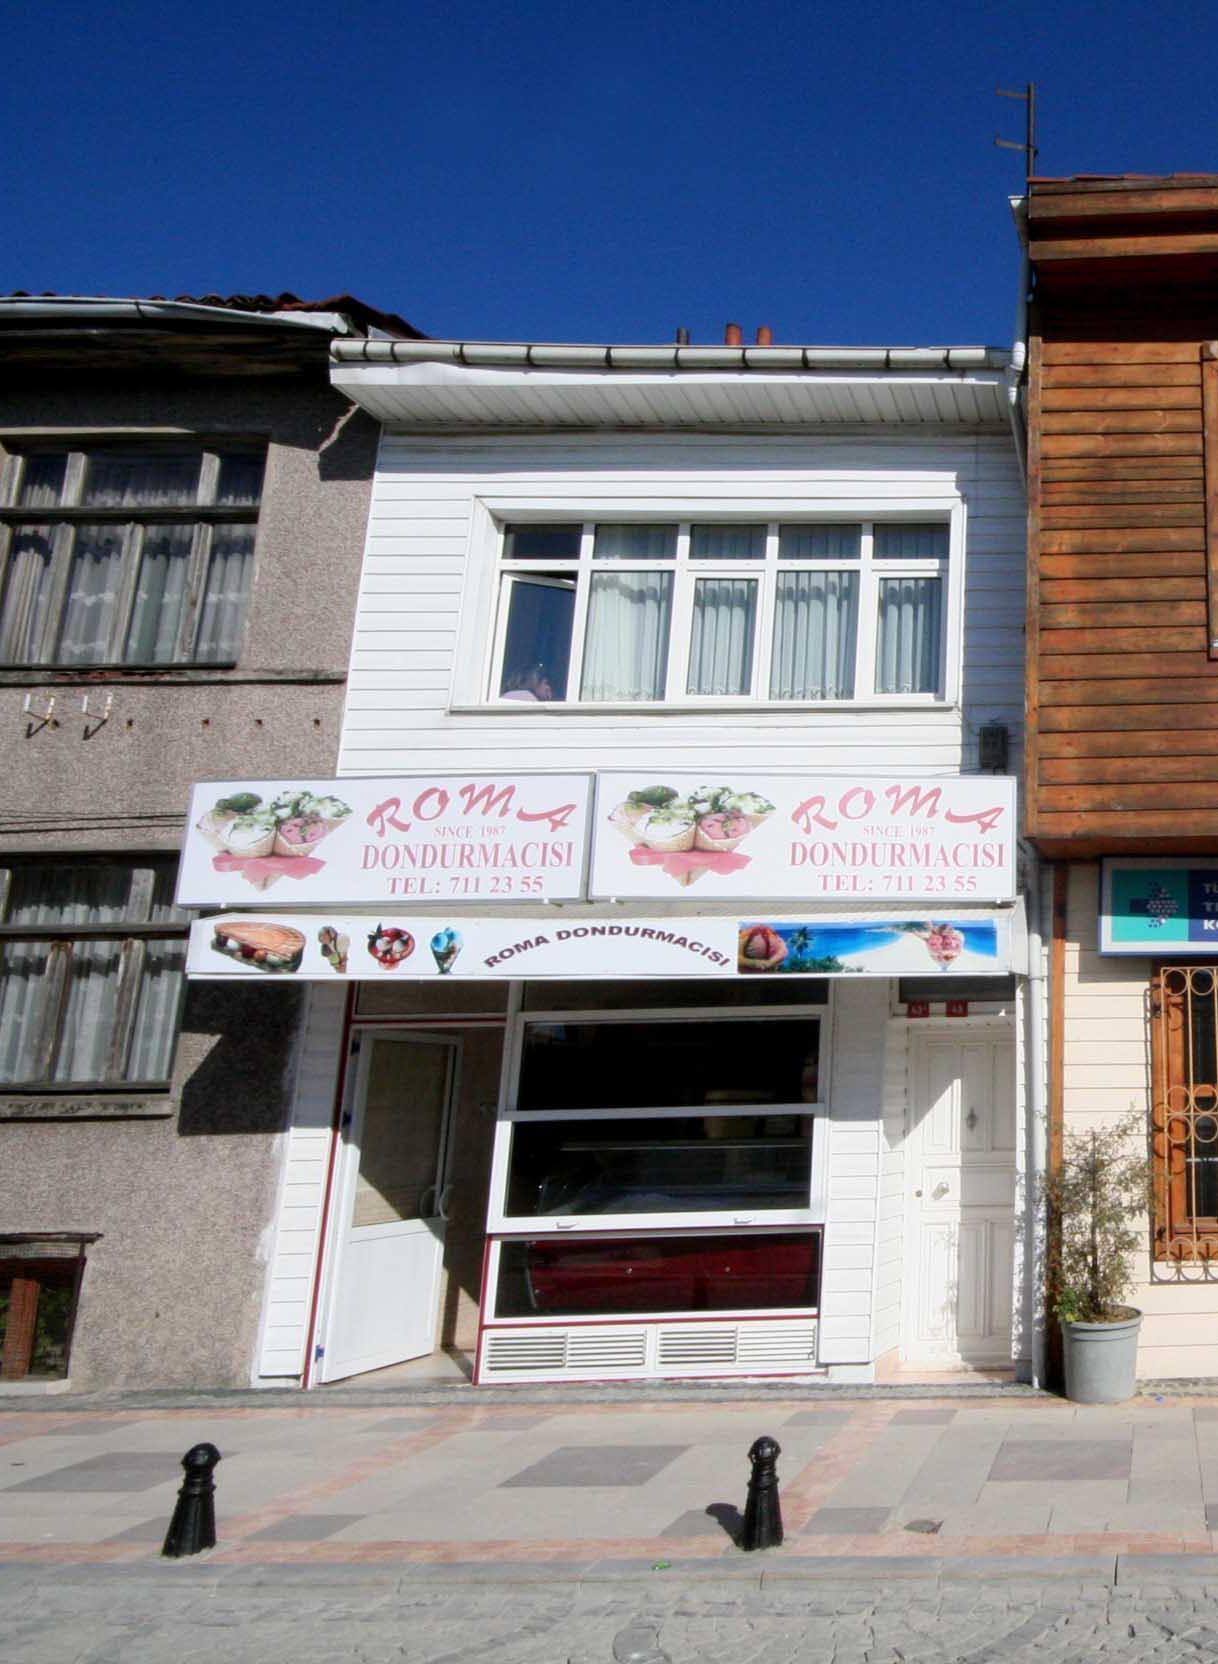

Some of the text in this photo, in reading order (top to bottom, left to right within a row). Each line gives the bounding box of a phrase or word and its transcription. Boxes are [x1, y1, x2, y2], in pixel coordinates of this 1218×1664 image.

[366, 783, 577, 838] ROMA
[791, 785, 1005, 835] ROMA
[435, 826, 472, 839] SINCE
[863, 824, 936, 837] SINCE 1987
[360, 841, 575, 871] DONDURMACISI
[789, 841, 1007, 868] DONDURMACISI
[387, 876, 544, 895] TEL: 711 23 55
[817, 874, 977, 891] TEL: 711 23 55
[484, 925, 731, 968] ROMA DONDURMACISI
